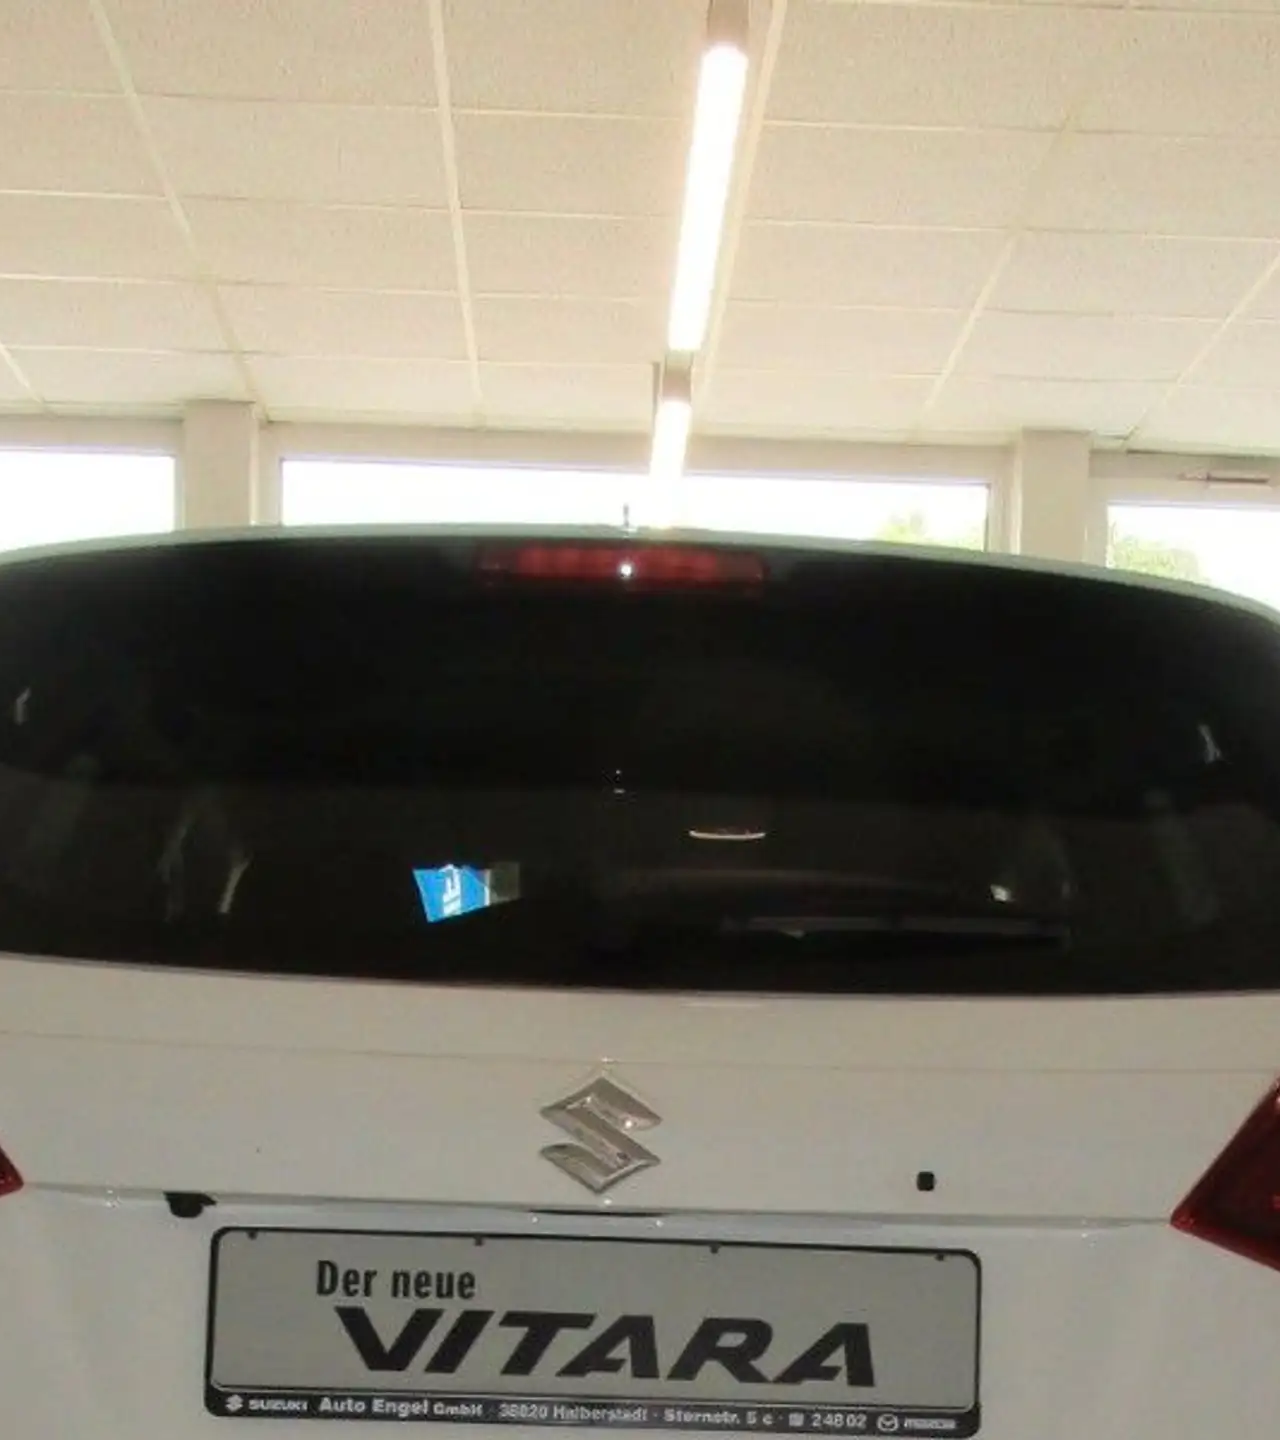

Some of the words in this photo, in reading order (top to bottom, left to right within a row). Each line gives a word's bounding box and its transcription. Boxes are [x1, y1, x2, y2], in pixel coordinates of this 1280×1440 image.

[316, 1259, 378, 1299] Der
[390, 1265, 476, 1300] neue
[334, 1305, 877, 1388] VITARA
[319, 1396, 366, 1413] Auto
[372, 1397, 428, 1417] Engel
